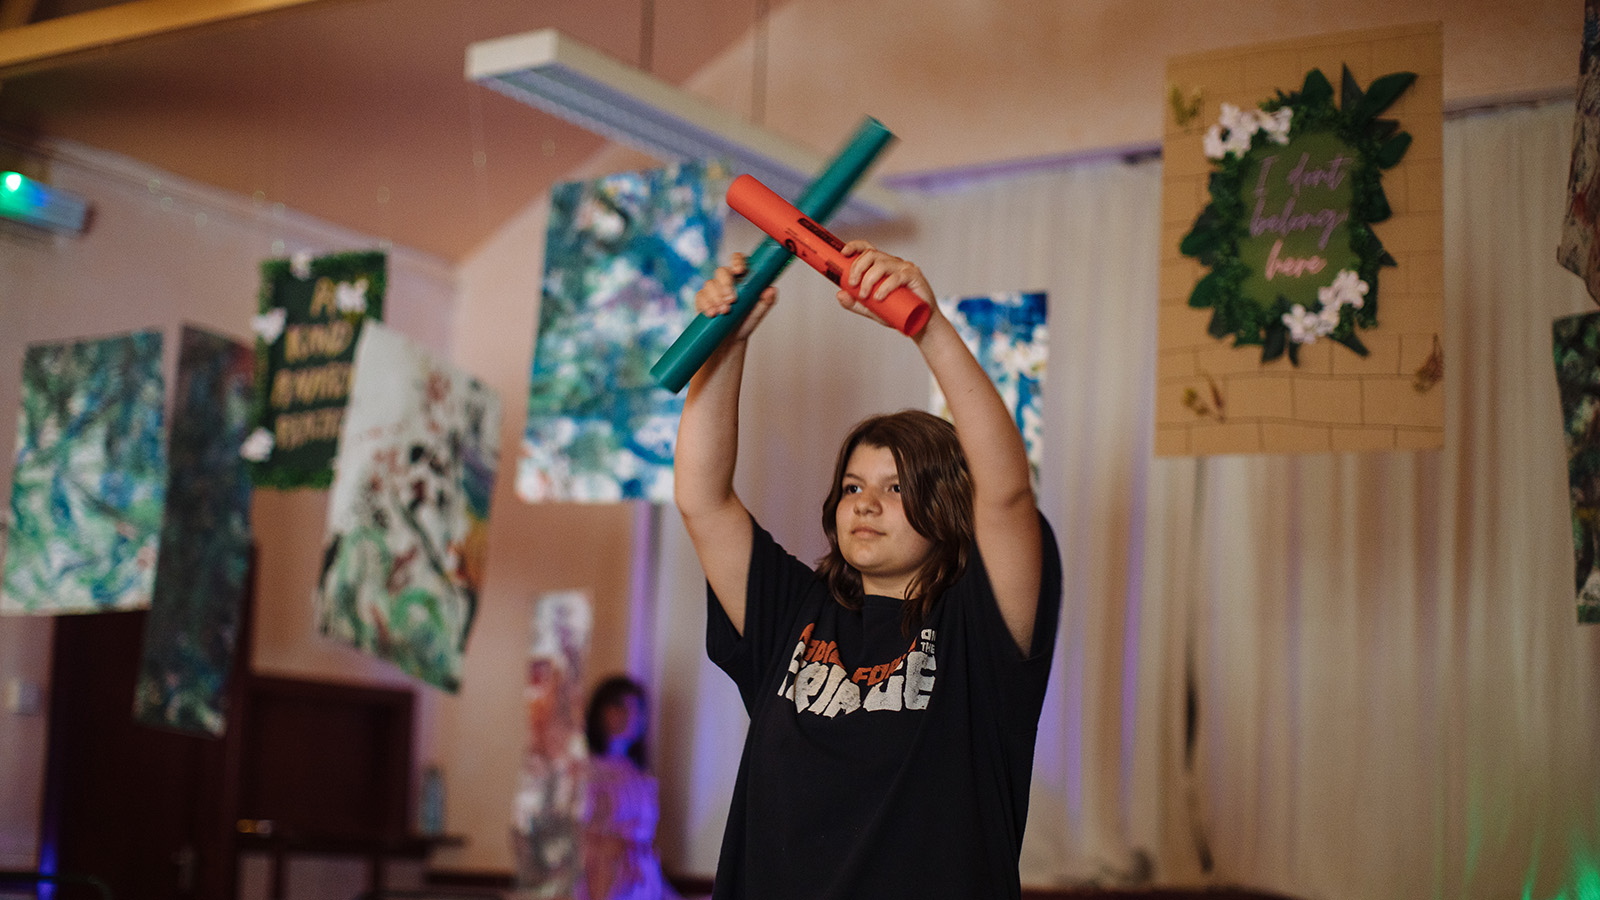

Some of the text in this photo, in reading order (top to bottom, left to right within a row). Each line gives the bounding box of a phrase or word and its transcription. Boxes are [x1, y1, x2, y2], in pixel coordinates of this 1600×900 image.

[1254, 155, 1279, 196] I
[1250, 197, 1349, 250] belong
[1265, 239, 1328, 281] here
[920, 641, 937, 654] THE
